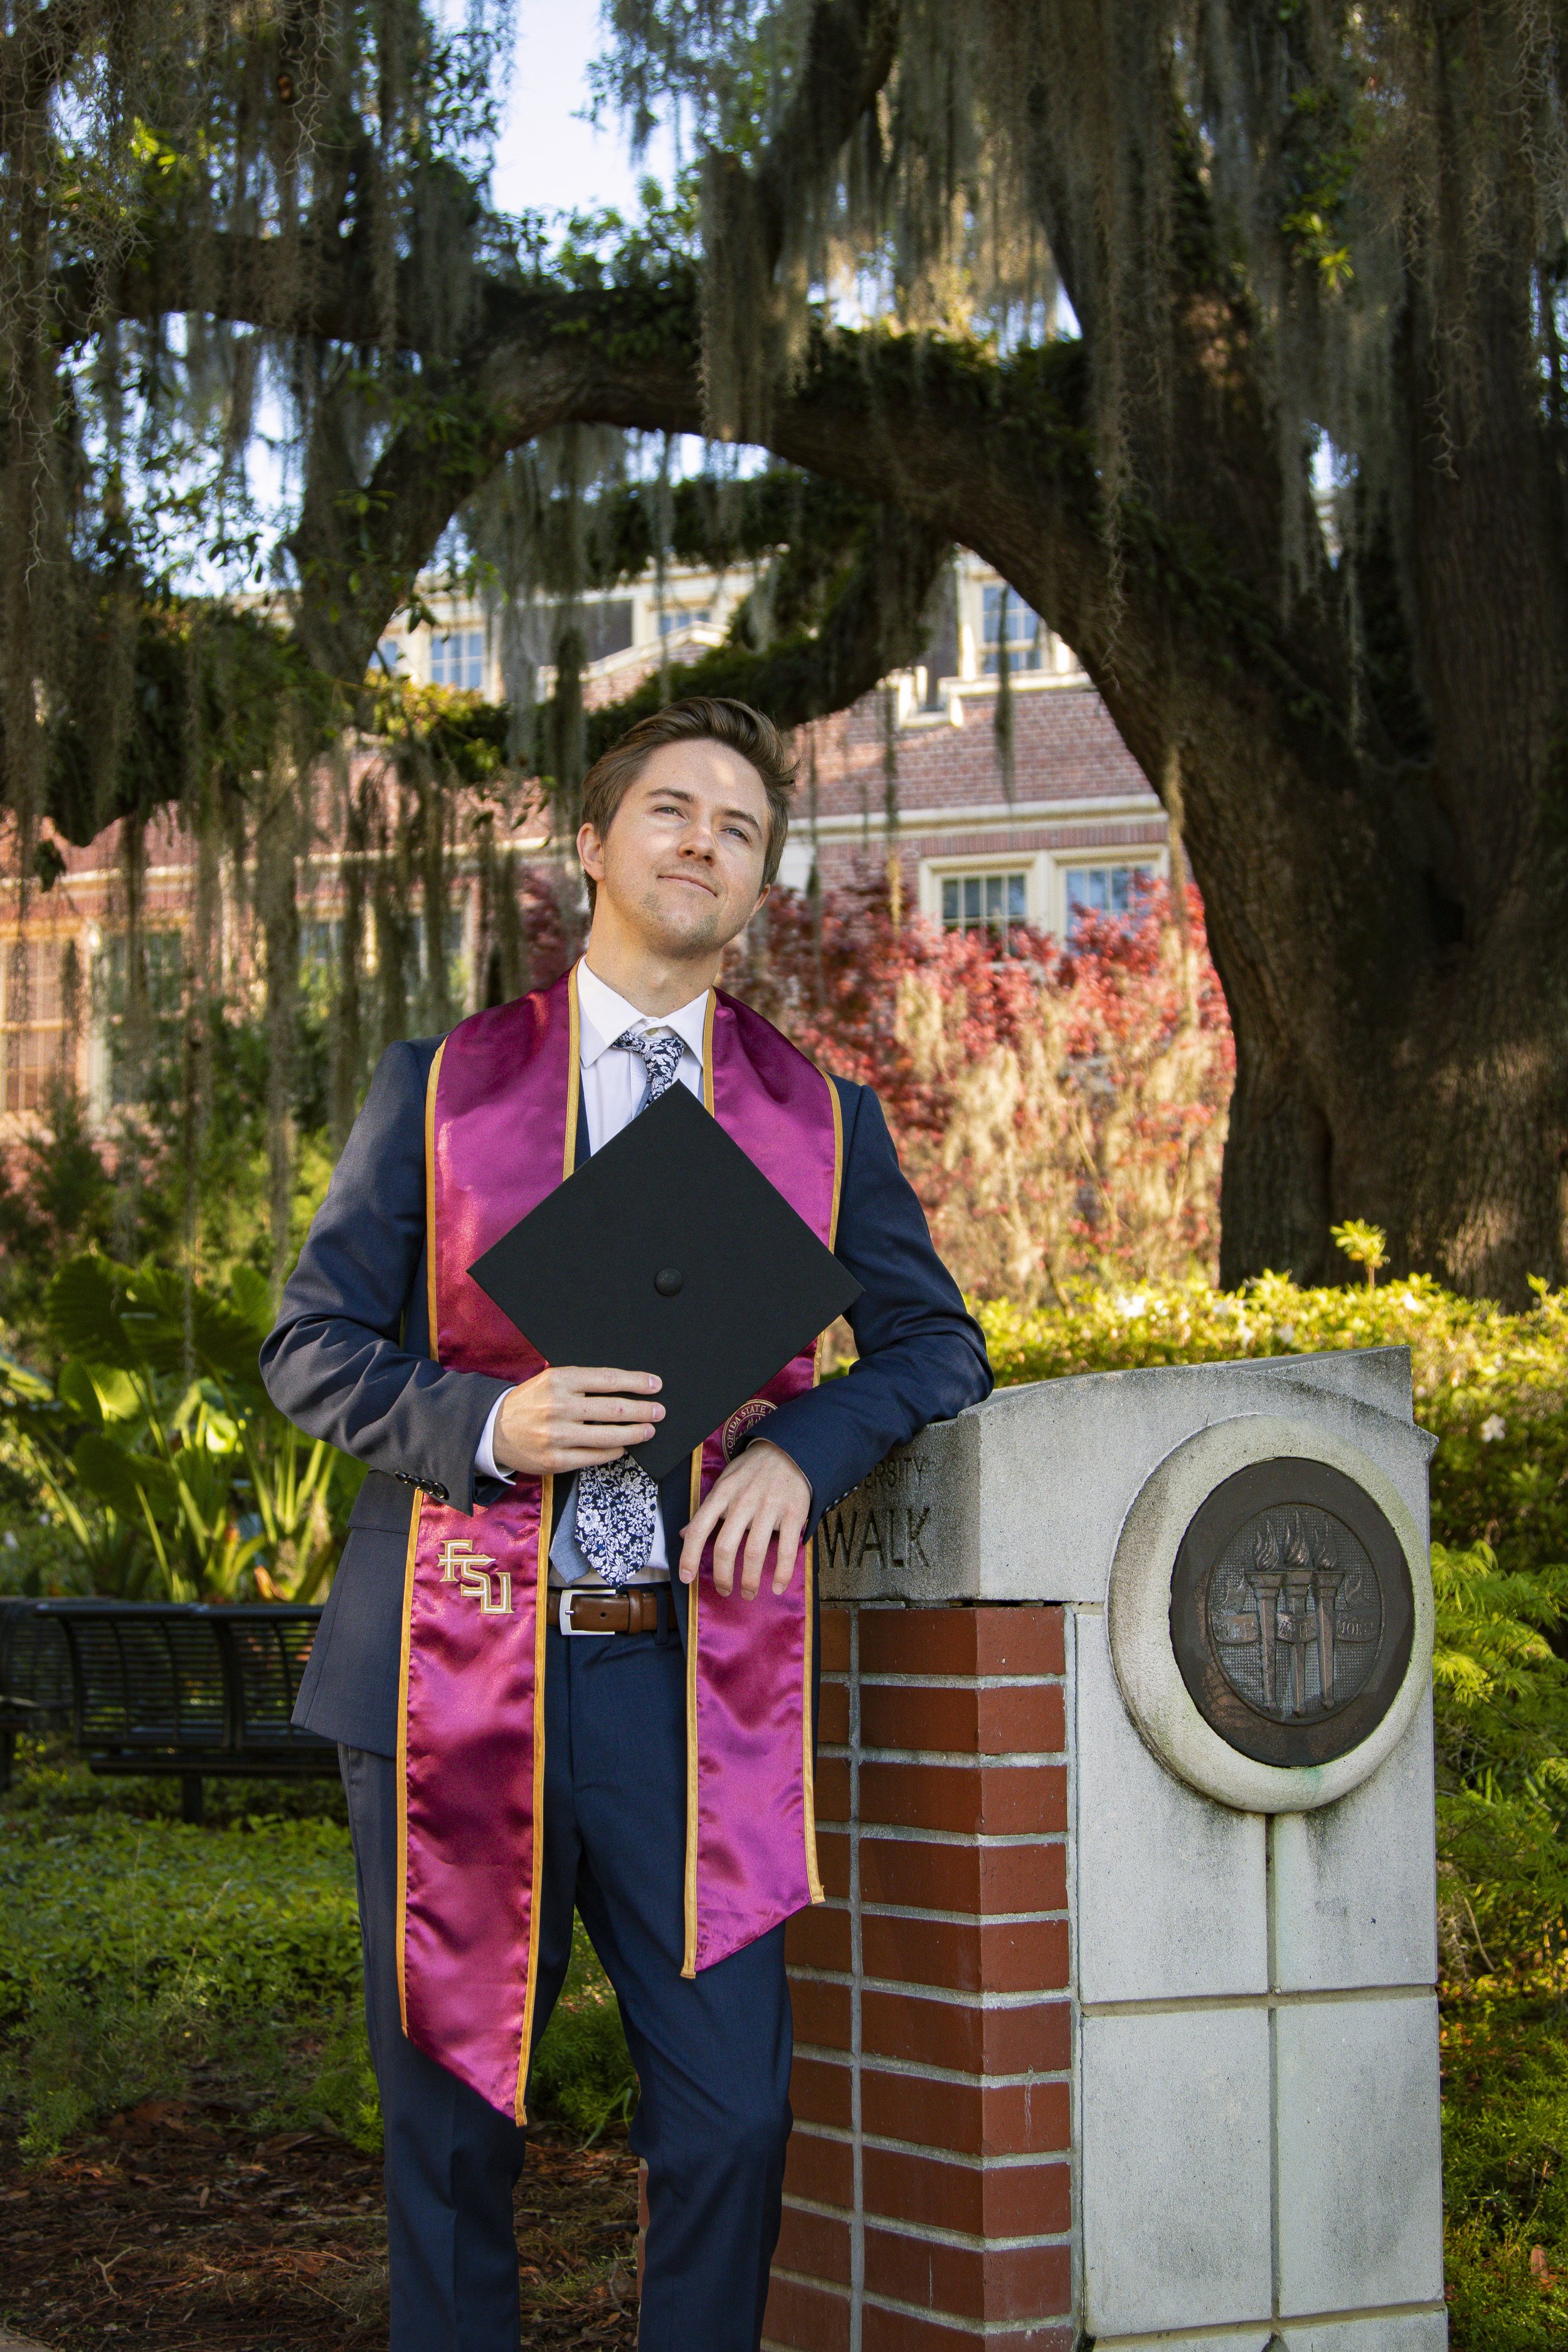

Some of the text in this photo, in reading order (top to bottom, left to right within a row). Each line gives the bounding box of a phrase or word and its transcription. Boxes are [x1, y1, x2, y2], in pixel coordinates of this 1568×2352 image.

[728, 1404, 766, 1454] ORIDA STATE
[822, 1507, 930, 1569] WALK
[437, 1539, 515, 1614] FSU
